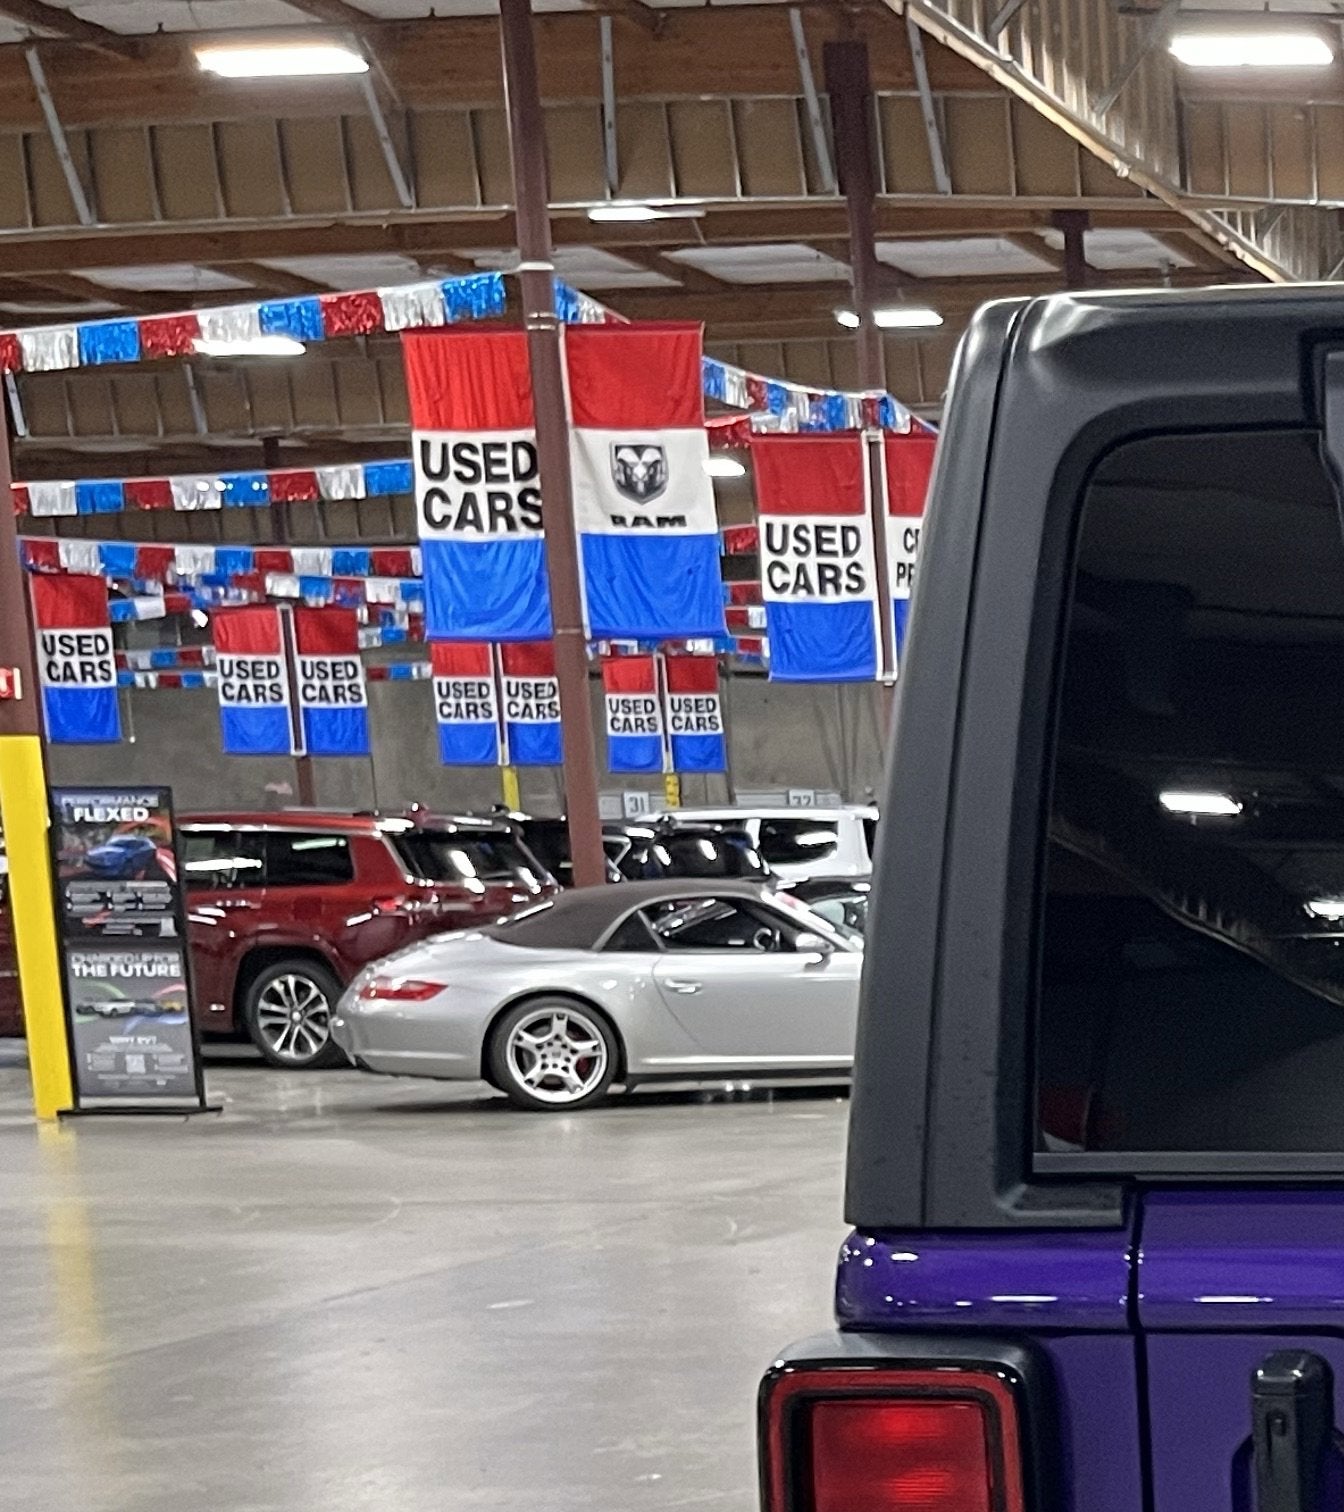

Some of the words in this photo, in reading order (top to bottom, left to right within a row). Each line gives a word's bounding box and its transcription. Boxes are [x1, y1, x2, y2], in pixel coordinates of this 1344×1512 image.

[420, 440, 538, 485] USED
[423, 487, 544, 533] CARS
[610, 514, 687, 528] RAM
[765, 522, 861, 558] USED
[767, 560, 866, 596] CARS
[42, 634, 109, 657] USED
[46, 660, 112, 682] CARS
[219, 659, 280, 680] USED
[302, 660, 358, 681] USED
[221, 682, 284, 702] CARS
[302, 682, 364, 703] CARS
[437, 681, 490, 699] USED
[506, 681, 556, 700] USED
[438, 701, 493, 720] CARS
[506, 701, 560, 720] CARS
[609, 698, 655, 714] USED
[670, 697, 717, 714] USED
[610, 716, 658, 733] CARS
[671, 715, 720, 731] CARS
